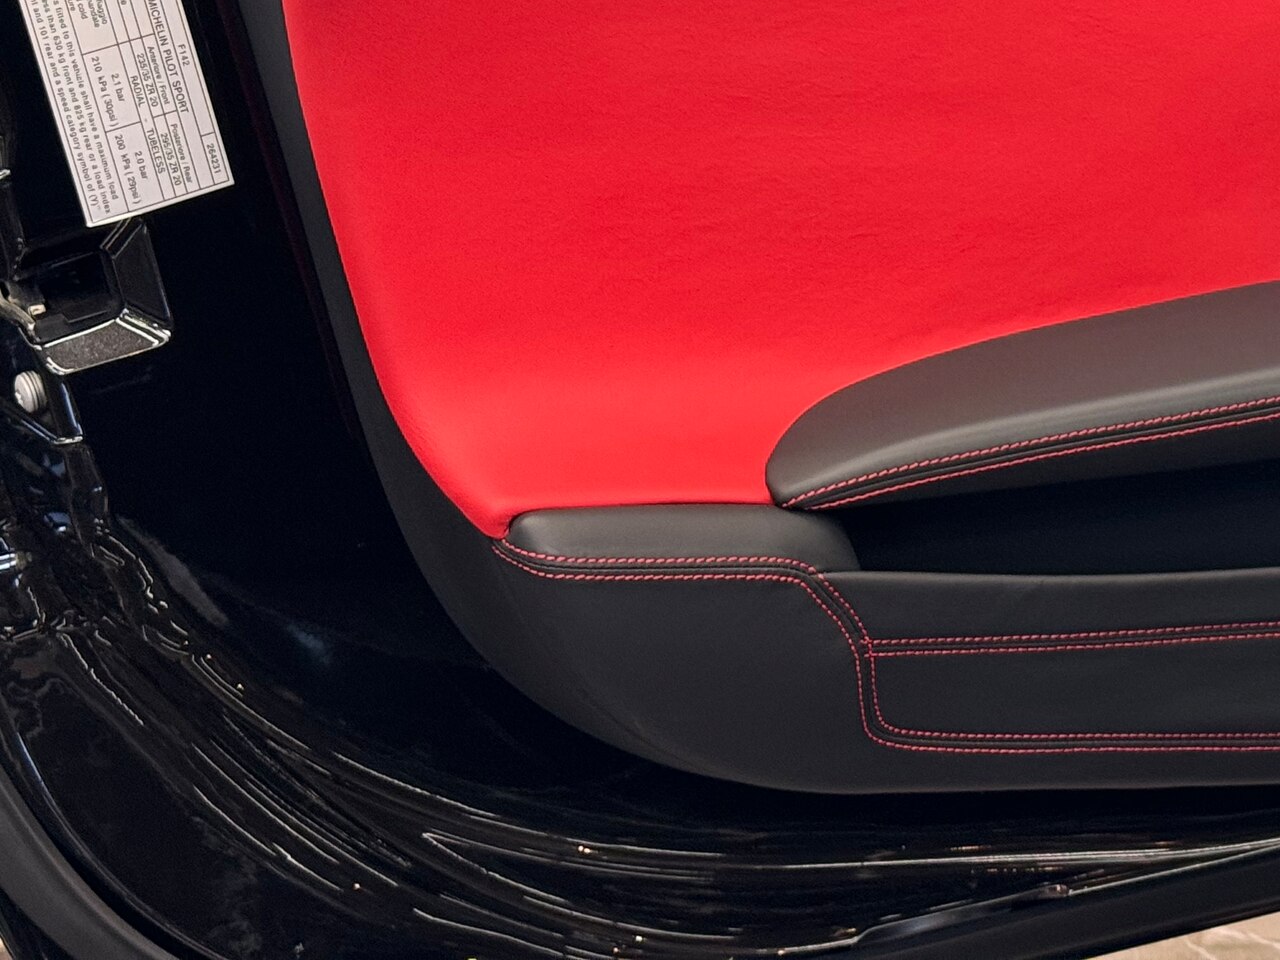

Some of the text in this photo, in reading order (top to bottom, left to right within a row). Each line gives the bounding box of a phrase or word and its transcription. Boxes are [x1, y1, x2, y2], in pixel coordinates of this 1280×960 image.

[55, 6, 67, 28] fitted
[77, 2, 88, 19] cold
[46, 14, 57, 33] than
[62, 30, 70, 39] to
[56, 51, 67, 63] kg
[65, 41, 76, 56] this
[177, 43, 190, 66] F142
[61, 64, 73, 85] front
[70, 58, 85, 88] vehicle
[91, 55, 102, 73] 210
[96, 75, 108, 92] kPa
[136, 52, 158, 107] 235/35 ZR 20
[146, 45, 163, 79] Anteriore
[158, 84, 170, 105] Front
[162, 48, 178, 78] PILOT
[171, 79, 188, 114] SPORT
[68, 86, 79, 102] and
[110, 72, 126, 102] 2.1 bar
[32, 7, 43, 23] and
[38, 25, 48, 40] 101
[43, 42, 53, 59] rear
[49, 61, 60, 77] and
[55, 86, 70, 113] speed
[63, 113, 82, 150] category
[75, 151, 91, 181] symbol
[86, 182, 94, 192] of
[80, 89, 92, 110] shall
[77, 121, 88, 132] kg
[86, 111, 98, 132] have
[130, 74, 146, 107] RADIAL
[145, 127, 165, 173] TUBELESS
[82, 134, 92, 151] rear
[114, 133, 126, 150] 200
[120, 153, 131, 169] kPa
[170, 123, 186, 160] Posteriore
[182, 165, 193, 183] Rear
[88, 153, 95, 162] or
[95, 140, 113, 180] maximum
[133, 150, 149, 180] 2.0 bar
[160, 132, 182, 186] 295/35 ZR 20
[206, 142, 221, 173] 264231
[93, 170, 105, 189] load
[107, 181, 119, 200] load
[99, 190, 112, 214] index
